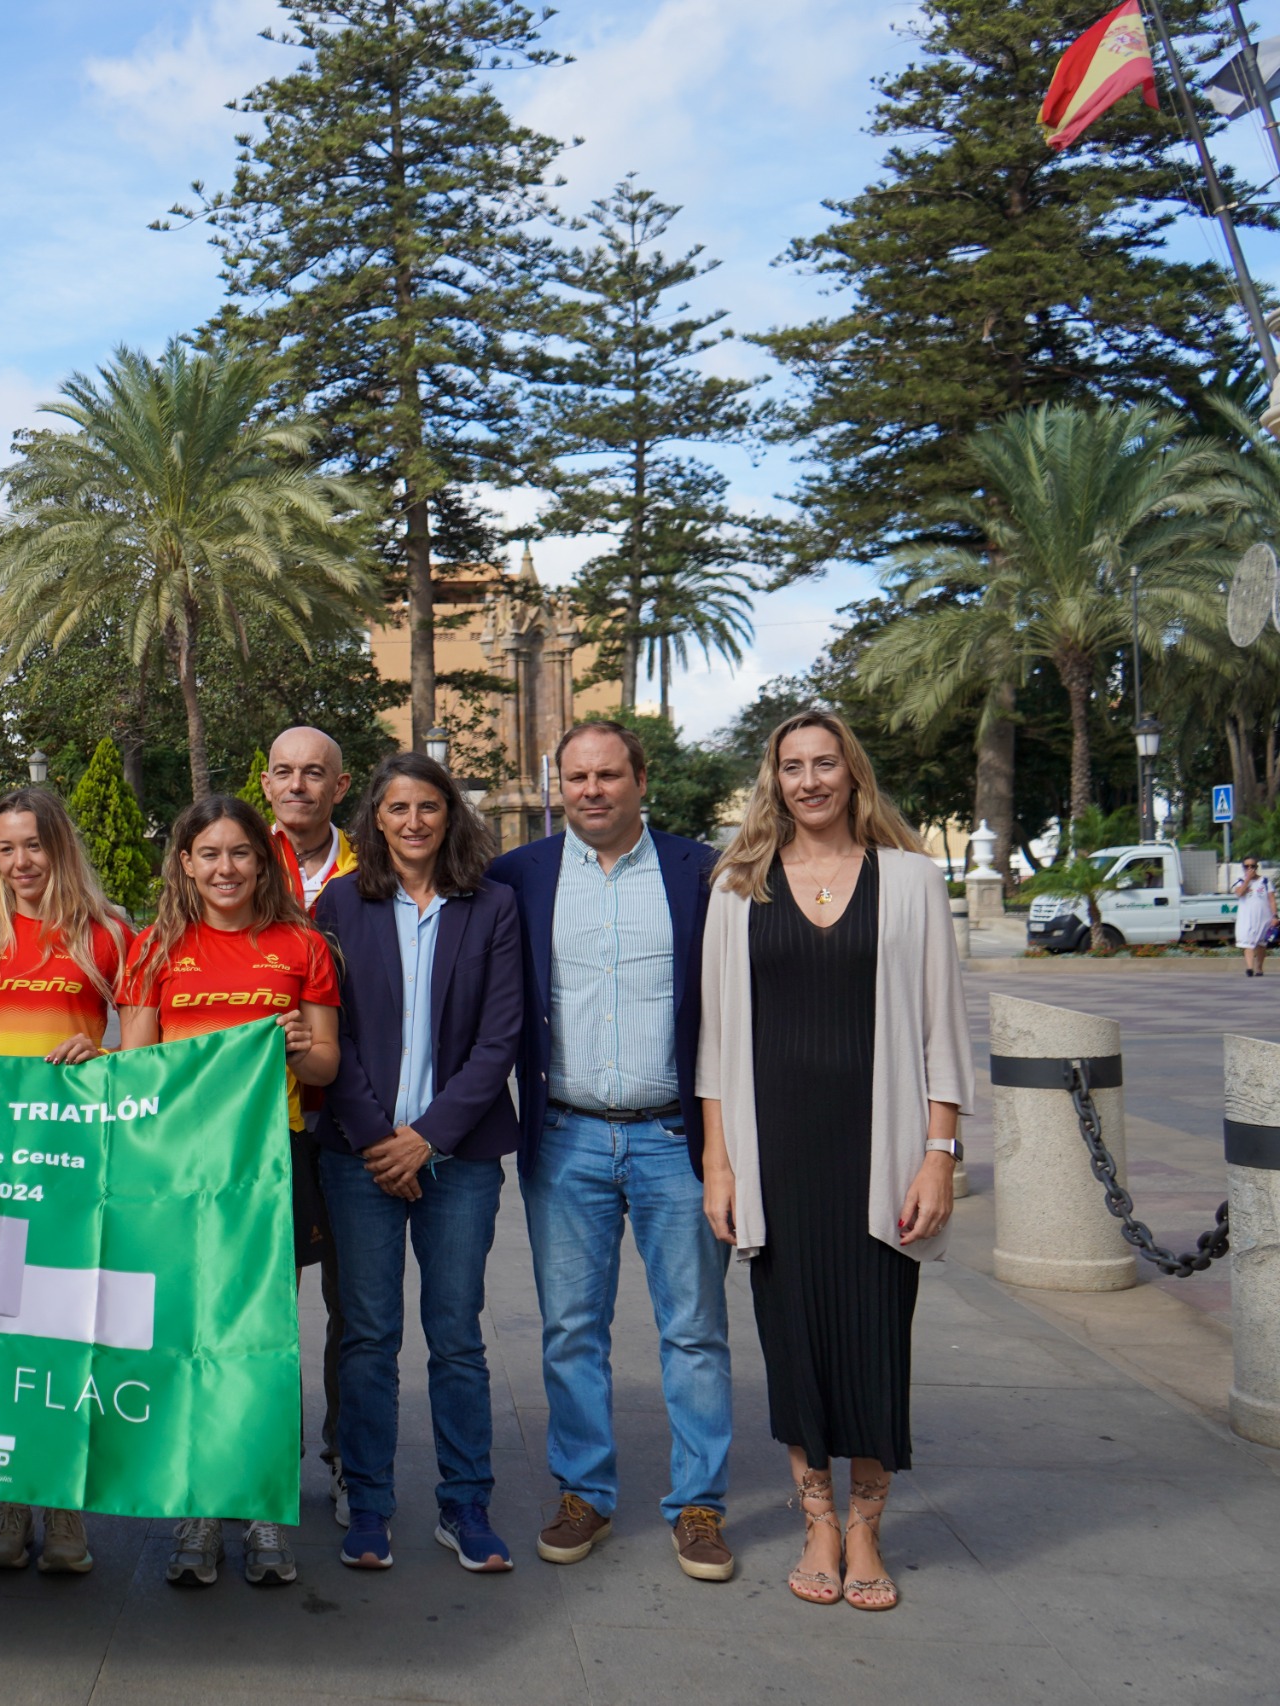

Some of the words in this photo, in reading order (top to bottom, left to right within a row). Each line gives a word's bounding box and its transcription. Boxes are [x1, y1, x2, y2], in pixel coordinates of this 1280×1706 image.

[171, 988, 291, 1008] españa
[8, 1095, 160, 1123] TRIATLÓN
[11, 1149, 86, 1169] Ceuta
[14, 1366, 150, 1423] FLAG
